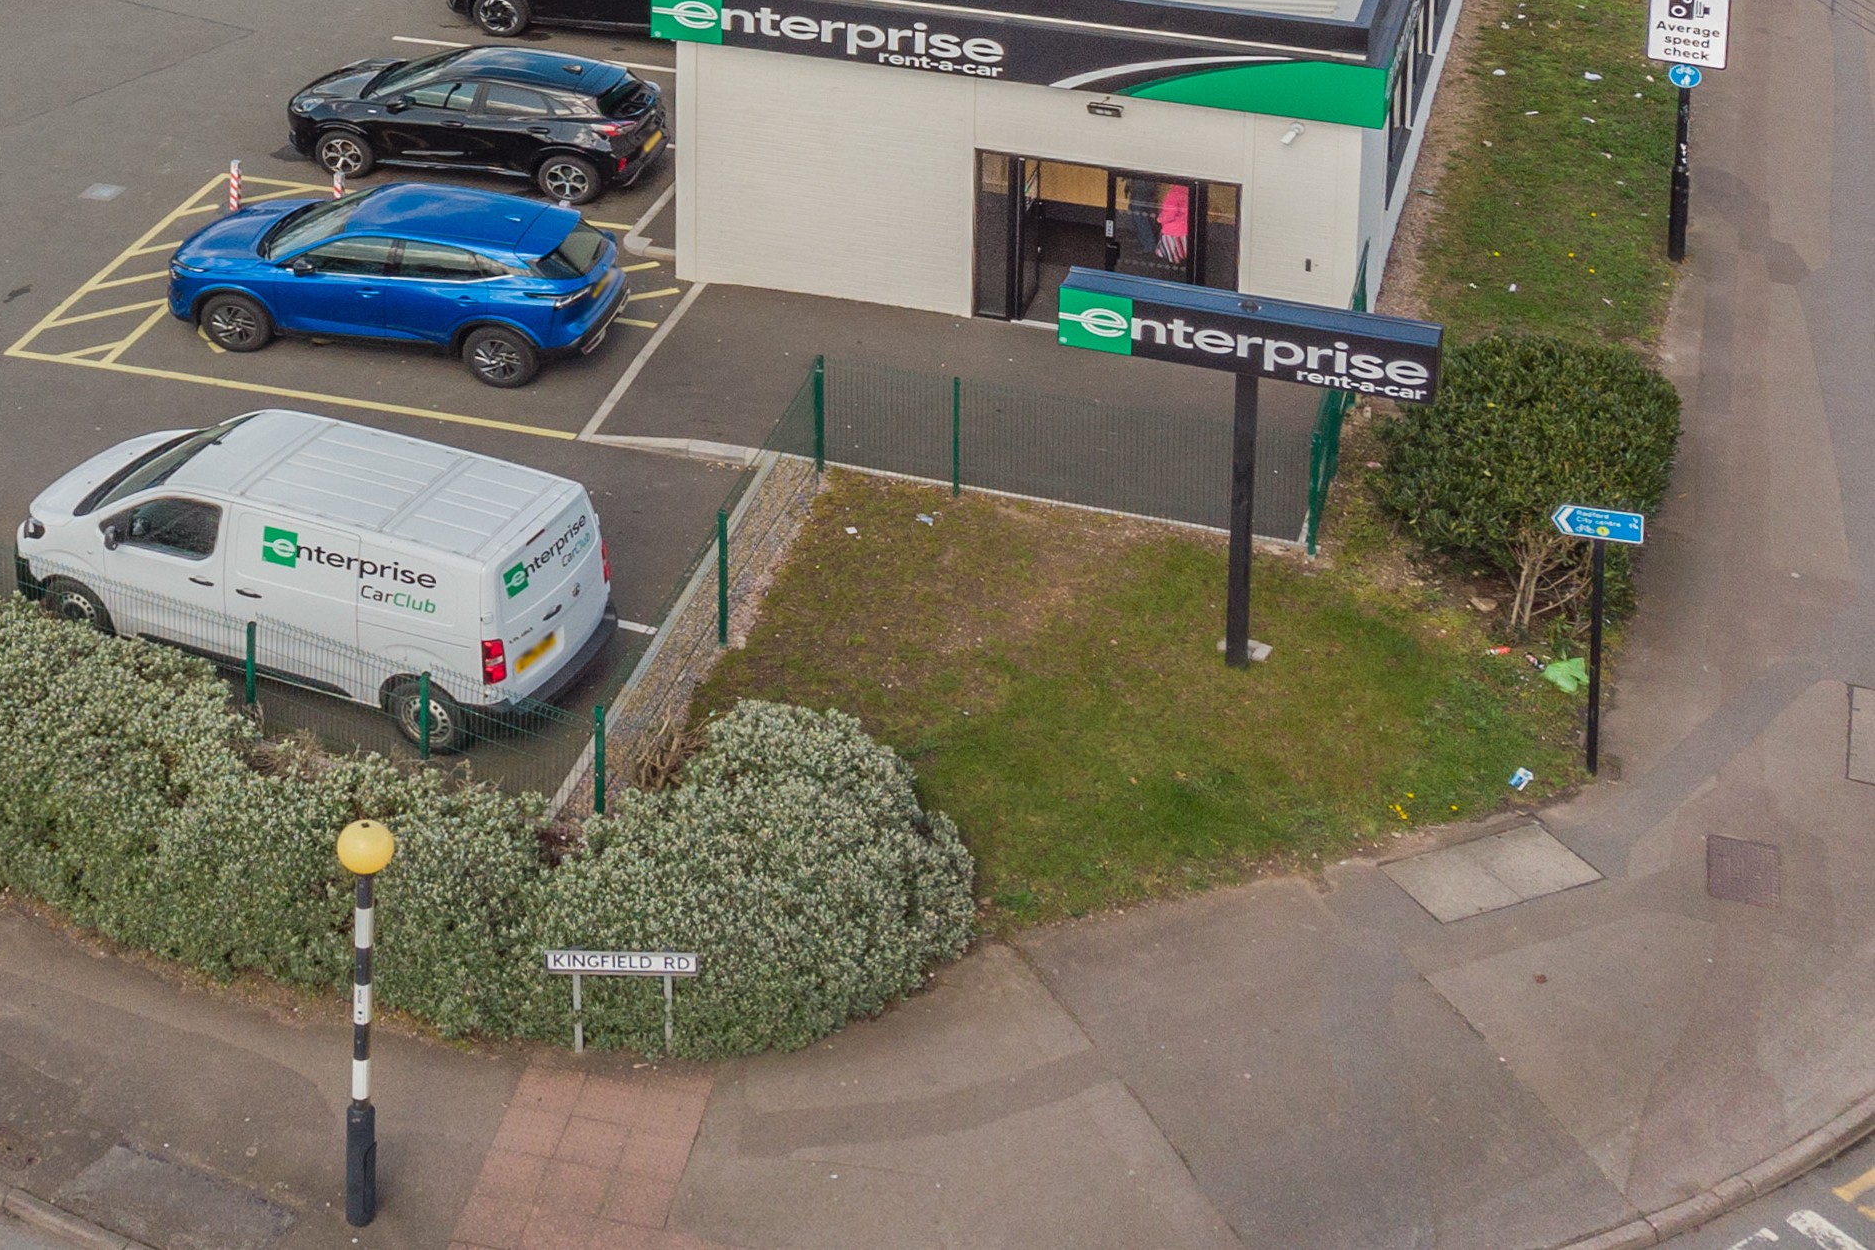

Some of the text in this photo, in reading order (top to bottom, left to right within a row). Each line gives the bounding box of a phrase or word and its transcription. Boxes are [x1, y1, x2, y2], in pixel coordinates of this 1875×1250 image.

[653, 0, 1005, 63] enterprise
[1656, 20, 1720, 38] Average
[1664, 35, 1710, 48] speed
[877, 50, 1003, 78] rent-a-car
[1664, 47, 1709, 61] check
[1059, 307, 1428, 385] enterprise
[1296, 369, 1427, 400] rent-a-car
[1576, 510, 1610, 519] Radford
[1576, 516, 1592, 524] City
[264, 538, 437, 588] enterprise
[506, 514, 587, 588] enterprise
[561, 532, 591, 567] CarClub
[360, 585, 436, 614] CarClub
[554, 954, 690, 970] KINGFIELD RD
